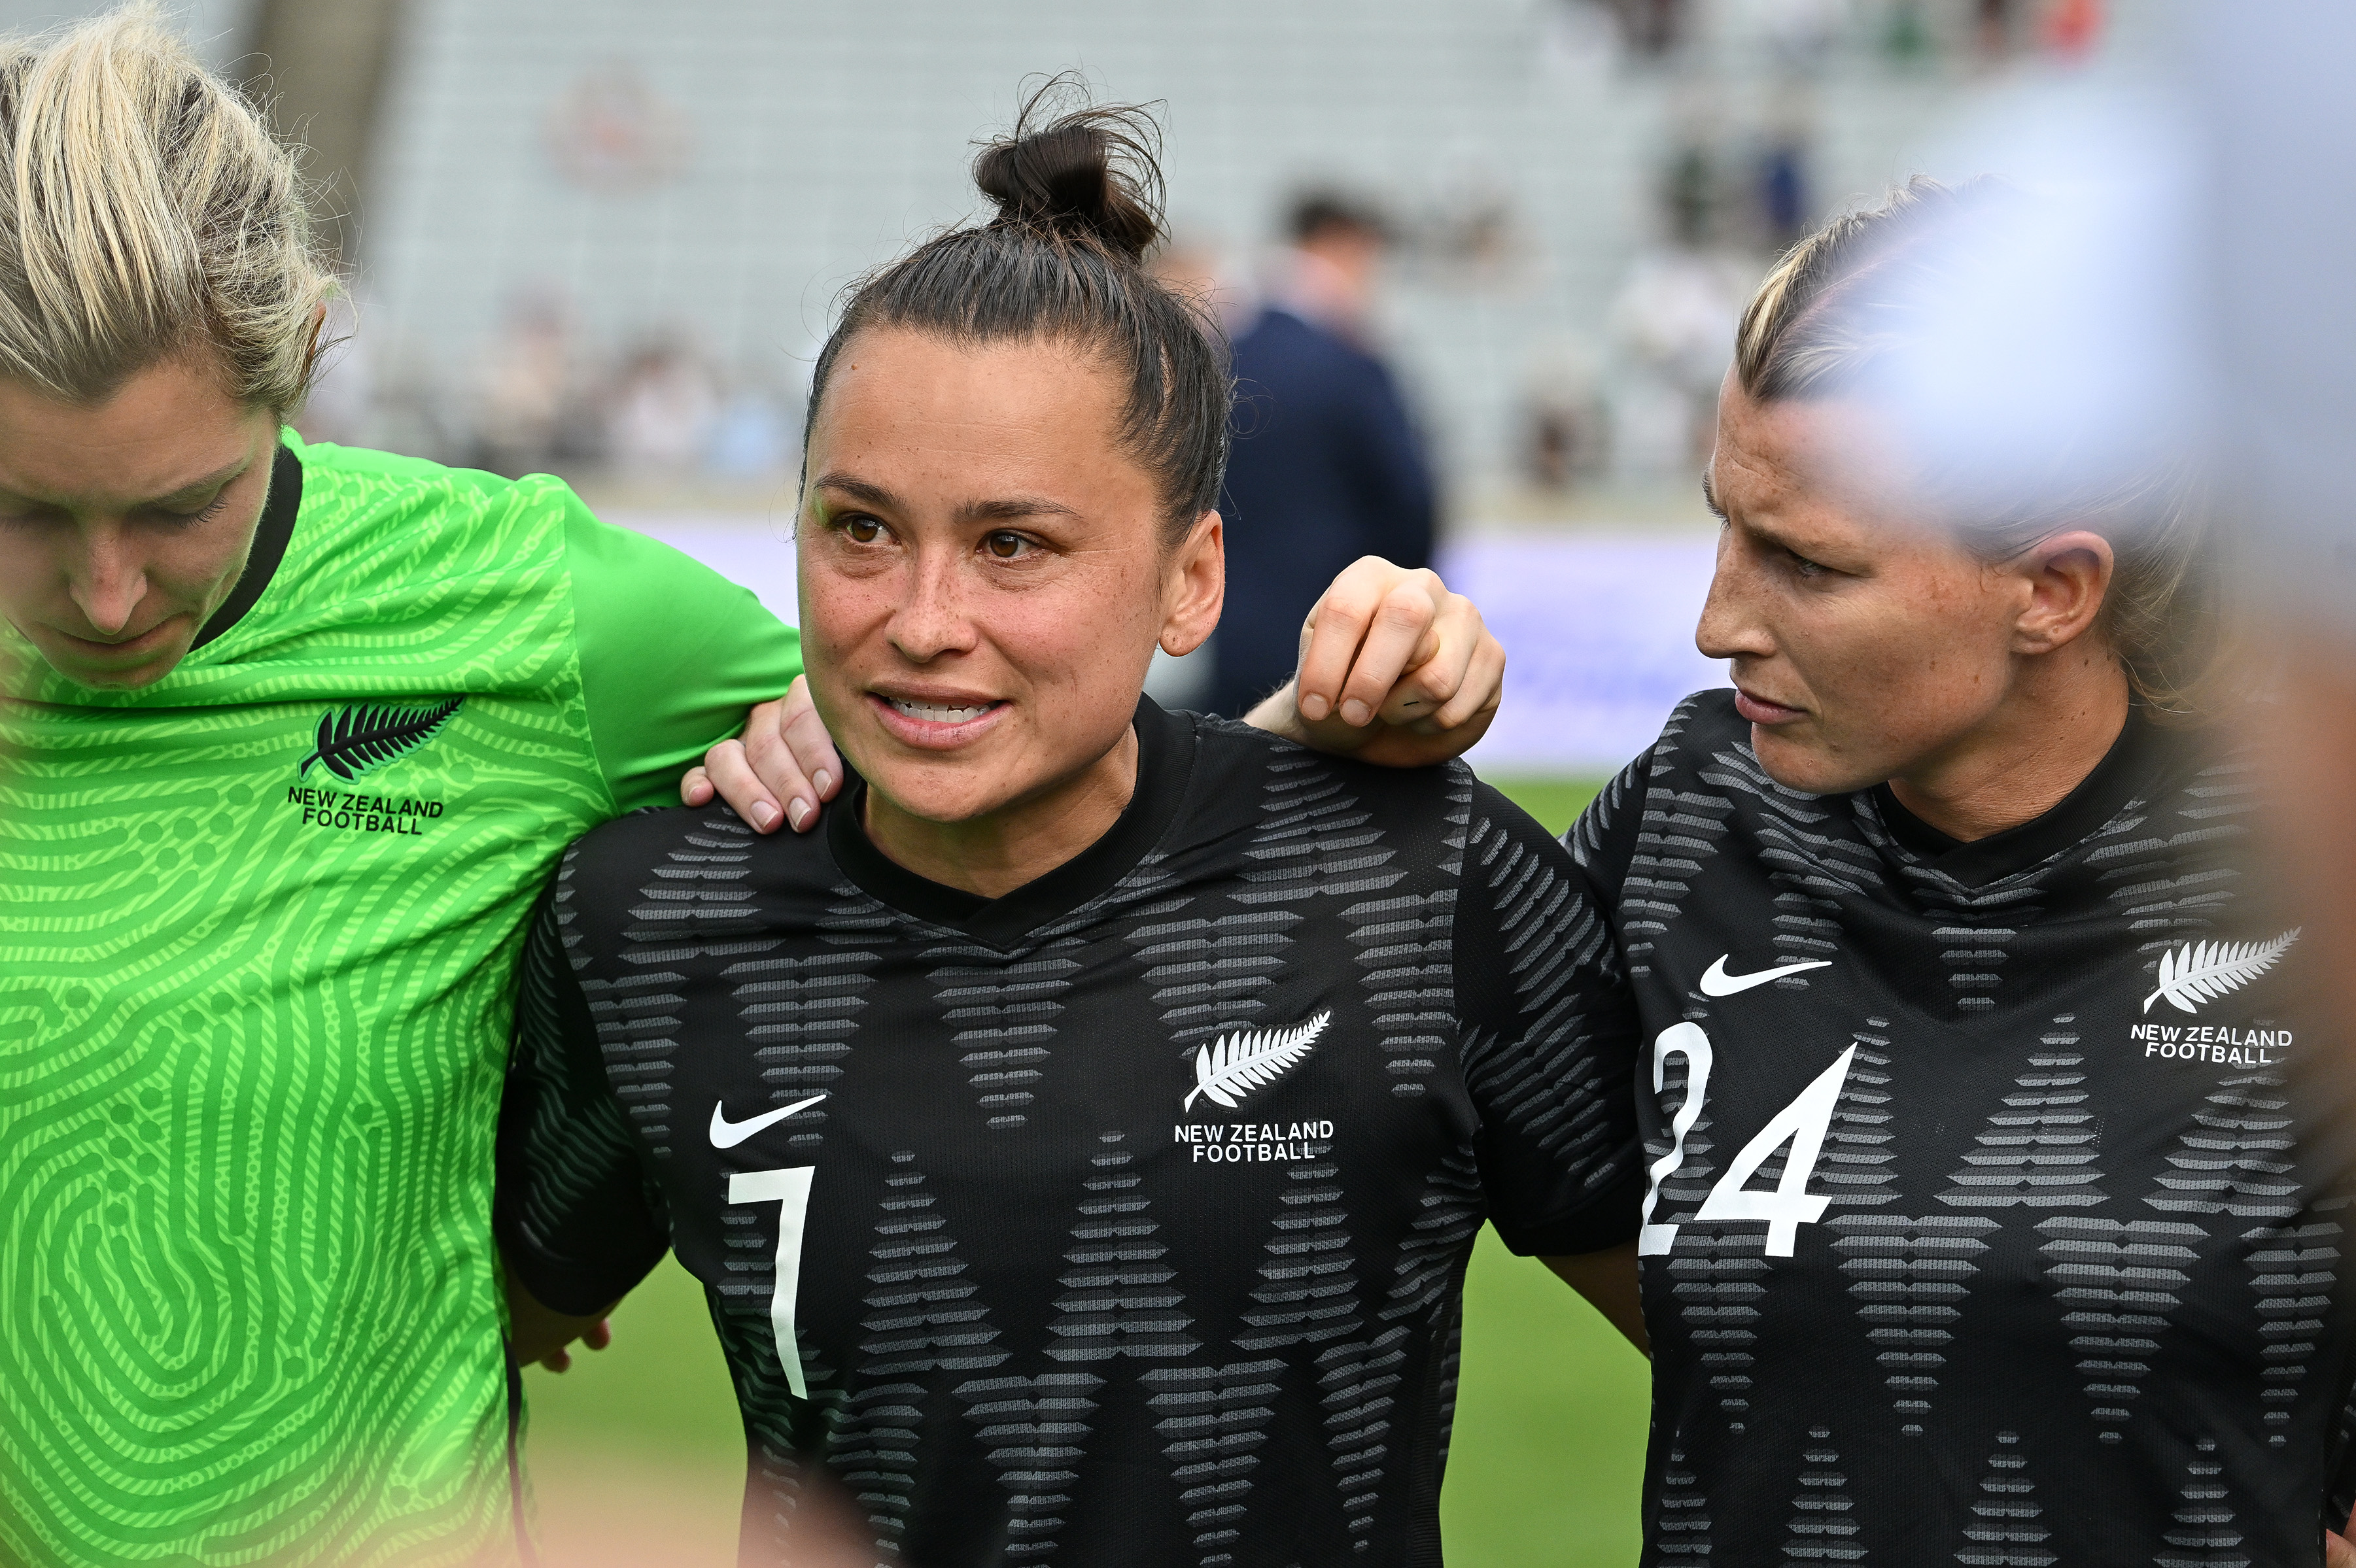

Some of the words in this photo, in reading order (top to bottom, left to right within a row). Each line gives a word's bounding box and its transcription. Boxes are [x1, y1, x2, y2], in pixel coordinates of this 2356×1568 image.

[288, 787, 337, 808] NEW
[341, 793, 443, 818] ZEALAND
[302, 808, 423, 835] FOOTBALL
[2130, 1024, 2181, 1042] NEW
[2185, 1026, 2293, 1047] ZEALAND
[2145, 1042, 2272, 1064] FOOTBALL
[1175, 1124, 1224, 1142] NEW
[1230, 1120, 1334, 1142] ZEALAND
[1638, 1021, 1858, 1257] 24
[1193, 1142, 1315, 1163] FOOTBALL
[728, 1165, 816, 1401] 7
